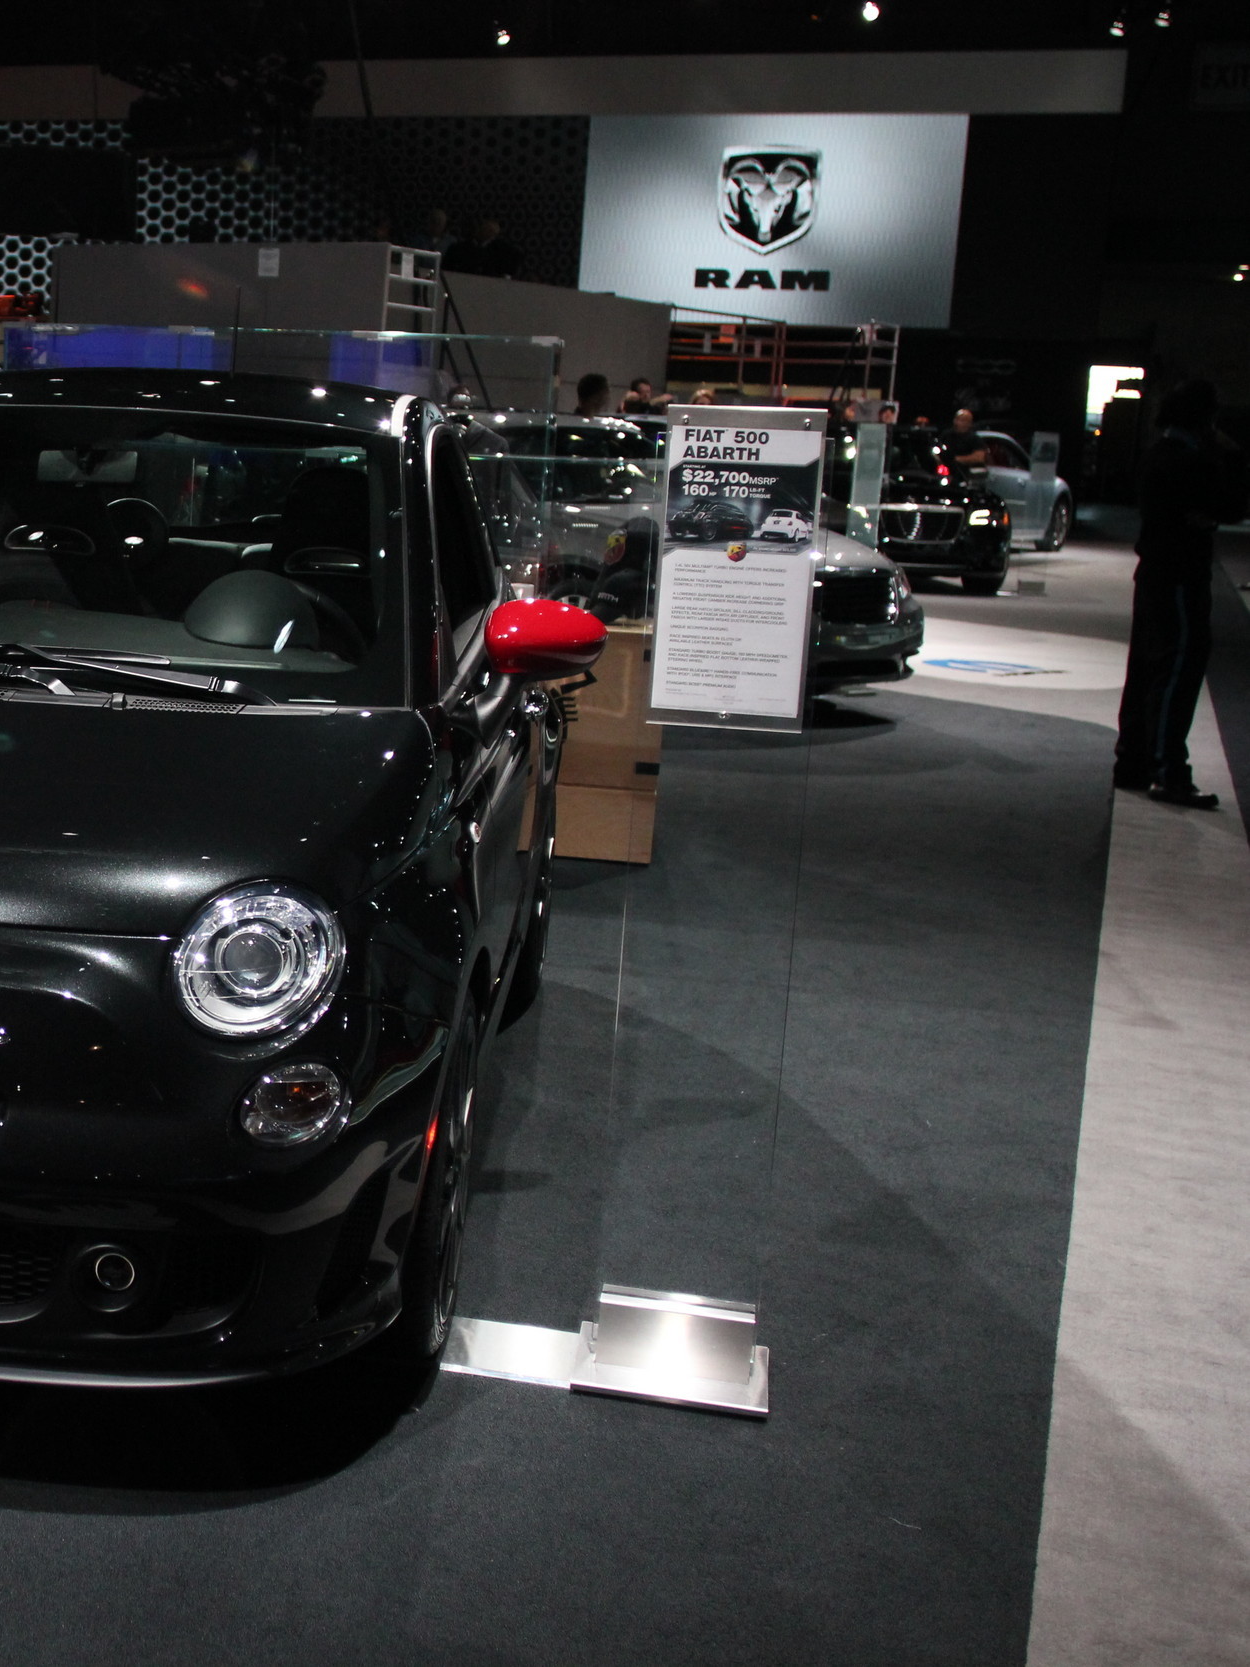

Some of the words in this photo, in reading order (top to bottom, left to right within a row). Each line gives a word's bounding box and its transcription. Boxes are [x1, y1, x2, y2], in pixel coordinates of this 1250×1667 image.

[694, 267, 830, 292] RAM
[684, 428, 725, 442] FIAT
[733, 430, 769, 444] 500
[682, 444, 760, 461] ABARTH
[682, 468, 750, 485] $22,700
[682, 484, 708, 496] 160
[723, 486, 748, 498] 170
